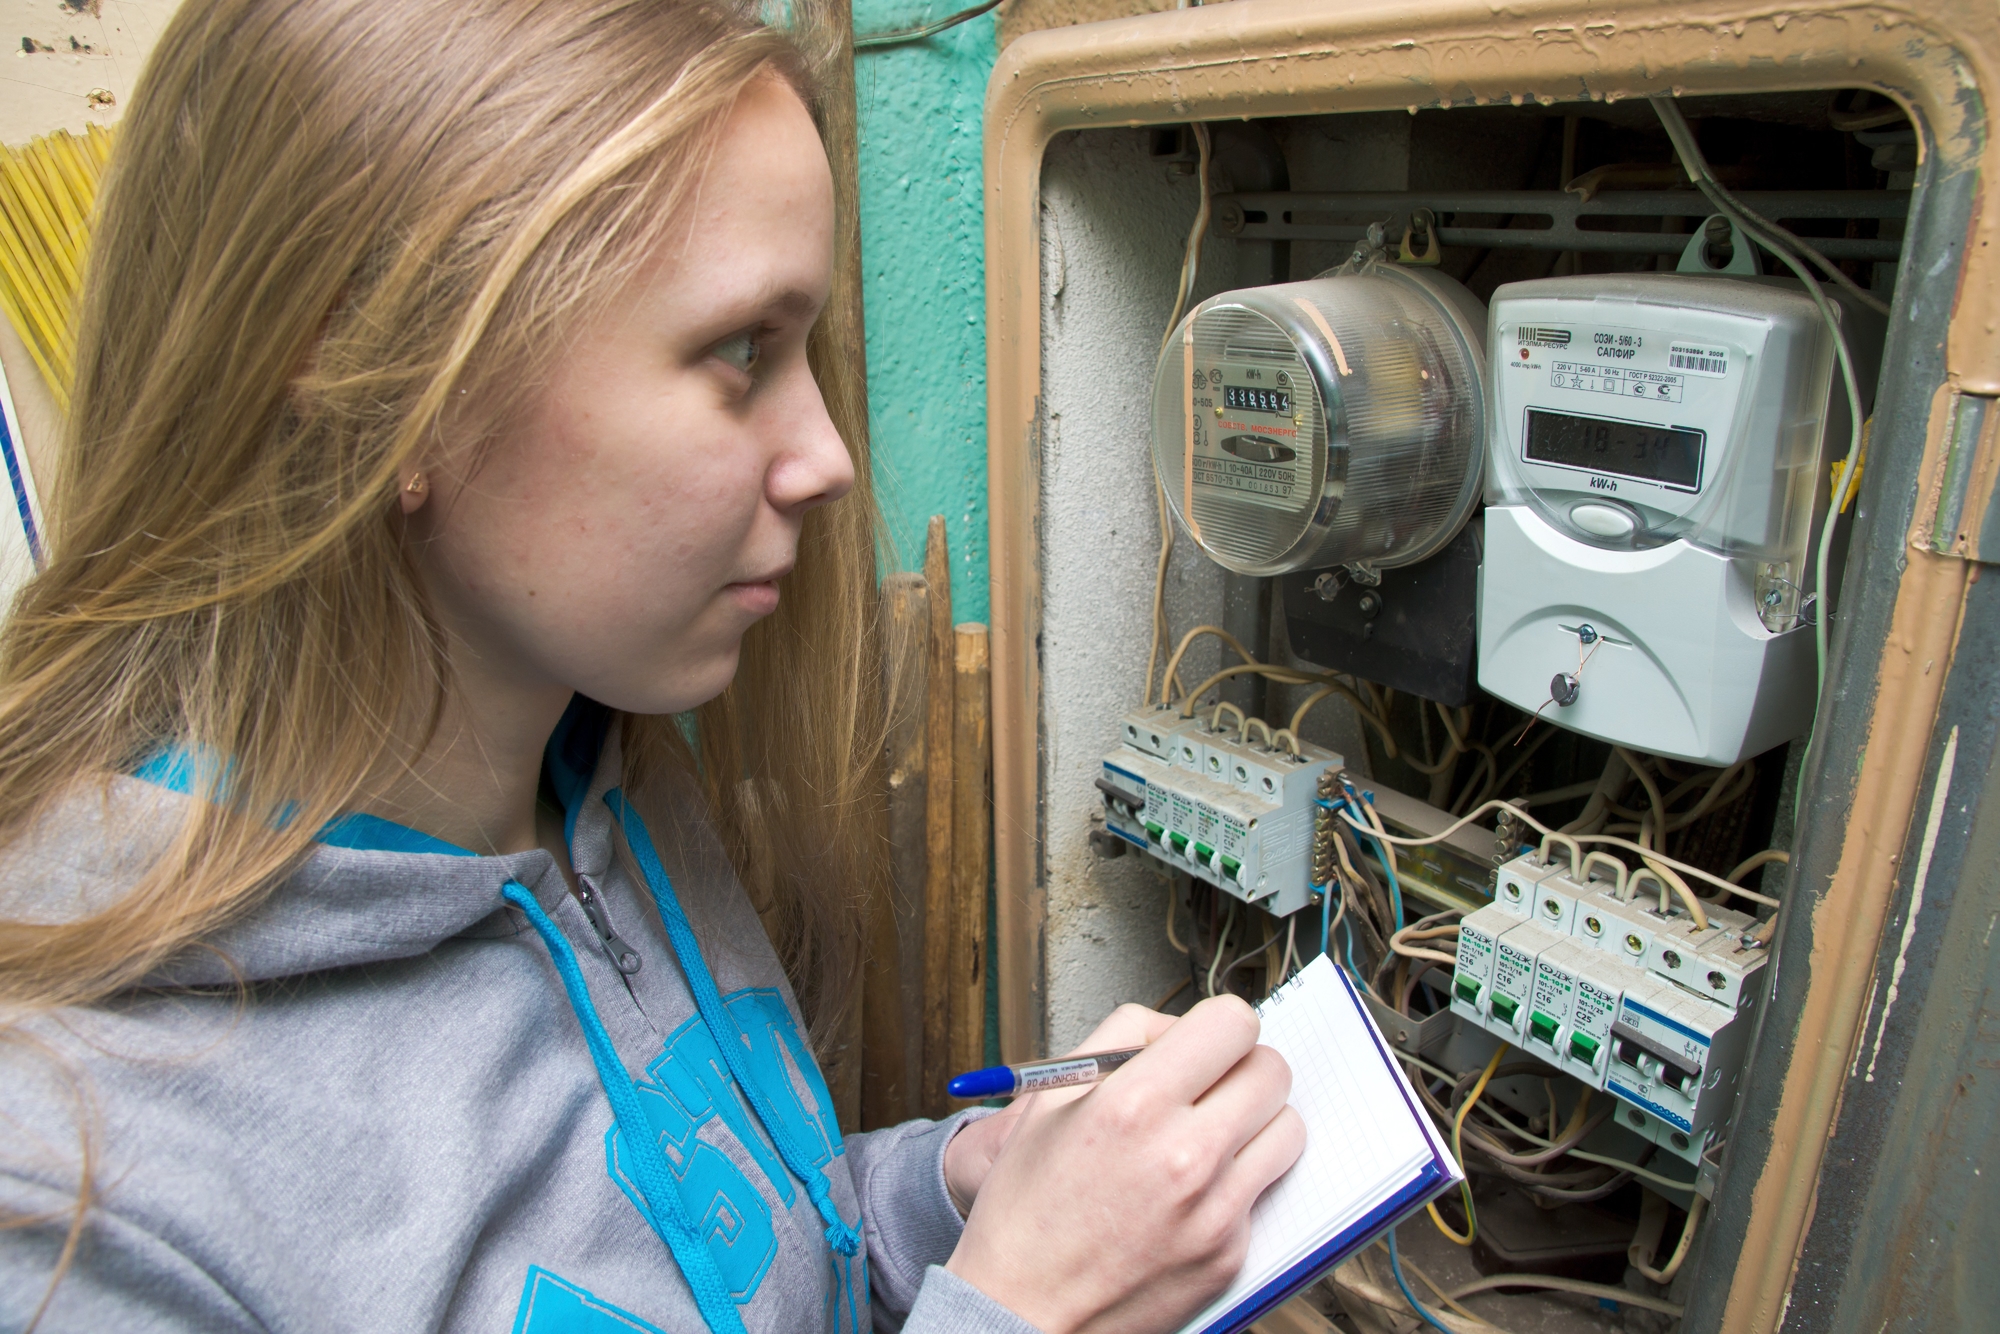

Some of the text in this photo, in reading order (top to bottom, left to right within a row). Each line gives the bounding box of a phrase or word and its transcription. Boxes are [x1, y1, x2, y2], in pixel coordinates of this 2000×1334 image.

[1594, 332, 1614, 345] СОЭИ
[1618, 335, 1632, 346] 5/60
[1596, 346, 1636, 360] САПФИР
[1628, 371, 1642, 379] ГОСТ
[1228, 463, 1253, 476] 10-40A
[1258, 468, 1296, 482] 220V 50Hz
[1474, 933, 1492, 947] ДЭК
[1460, 954, 1474, 966] C16
[1512, 952, 1532, 966] ДЭК
[1497, 972, 1512, 985] C16
[1552, 970, 1573, 985] ДЭК
[1536, 992, 1552, 1004] C16
[1594, 989, 1615, 1005] ДЭК
[1576, 1010, 1592, 1024] C25
[1026, 1078, 1038, 1088] 0.6
[1039, 1076, 1050, 1088] TIP
[1052, 1072, 1080, 1084] TECHNO
